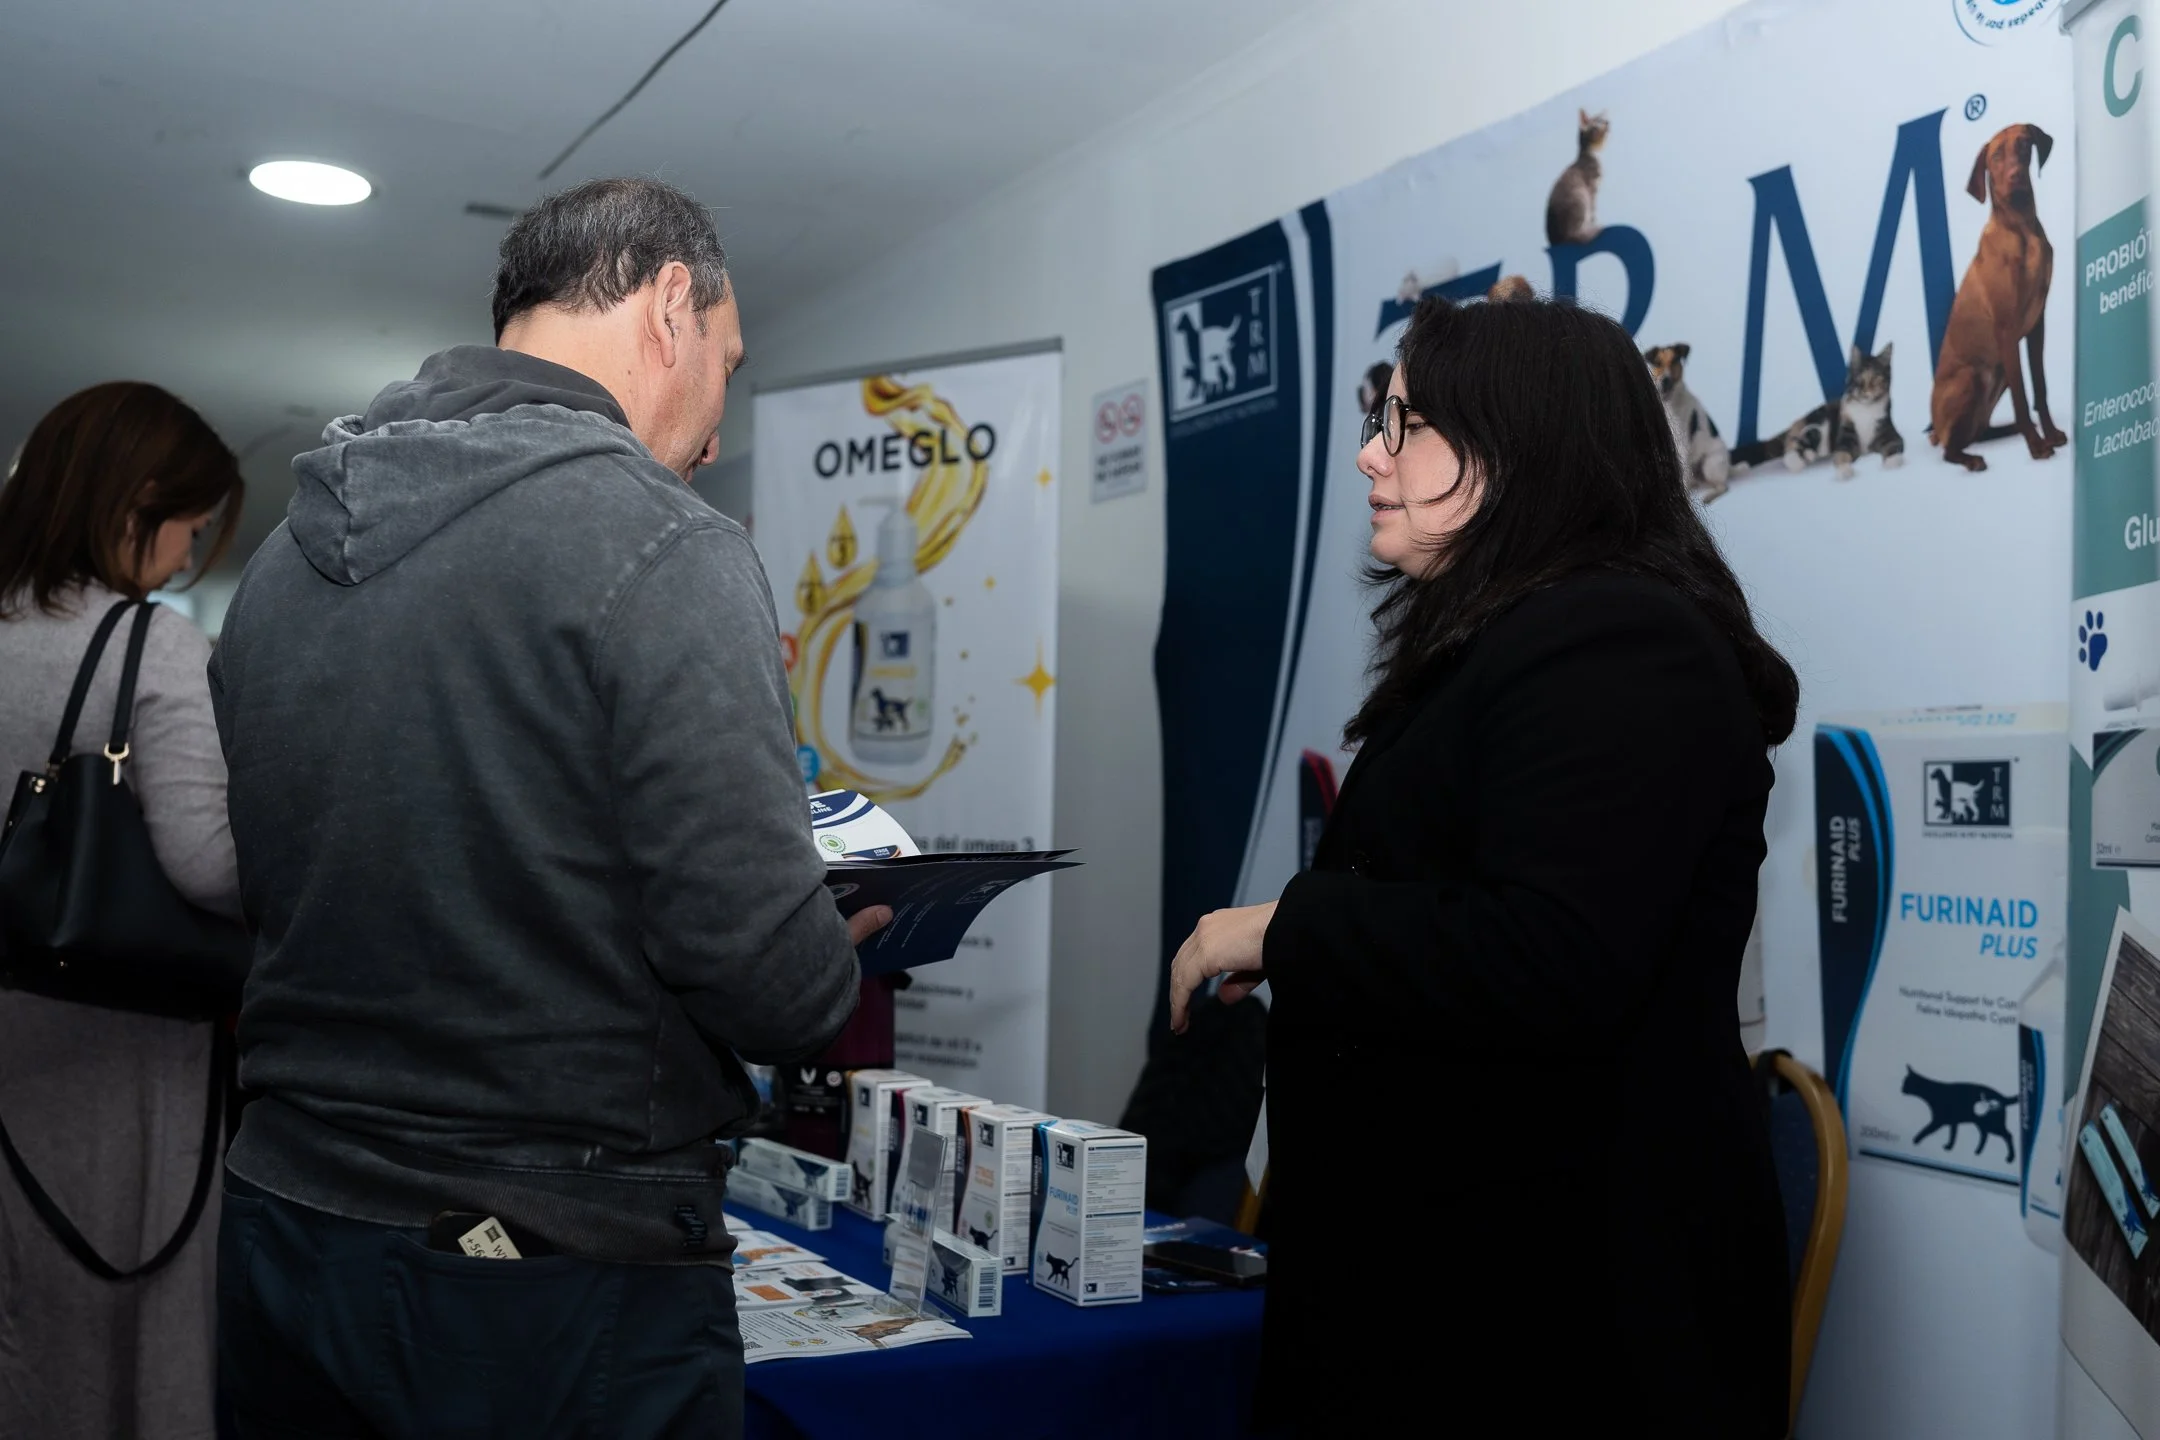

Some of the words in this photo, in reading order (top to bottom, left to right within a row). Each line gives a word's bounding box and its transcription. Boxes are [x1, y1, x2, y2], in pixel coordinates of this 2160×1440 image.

[1375, 107, 1960, 446] RM
[814, 422, 997, 479] OMEGLO
[1988, 766, 2006, 819] TRM
[1829, 815, 1848, 923] FURINAID
[1901, 893, 2038, 928] FURINAID
[1980, 933, 2037, 958] PLUS
[466, 1237, 487, 1257] +56
